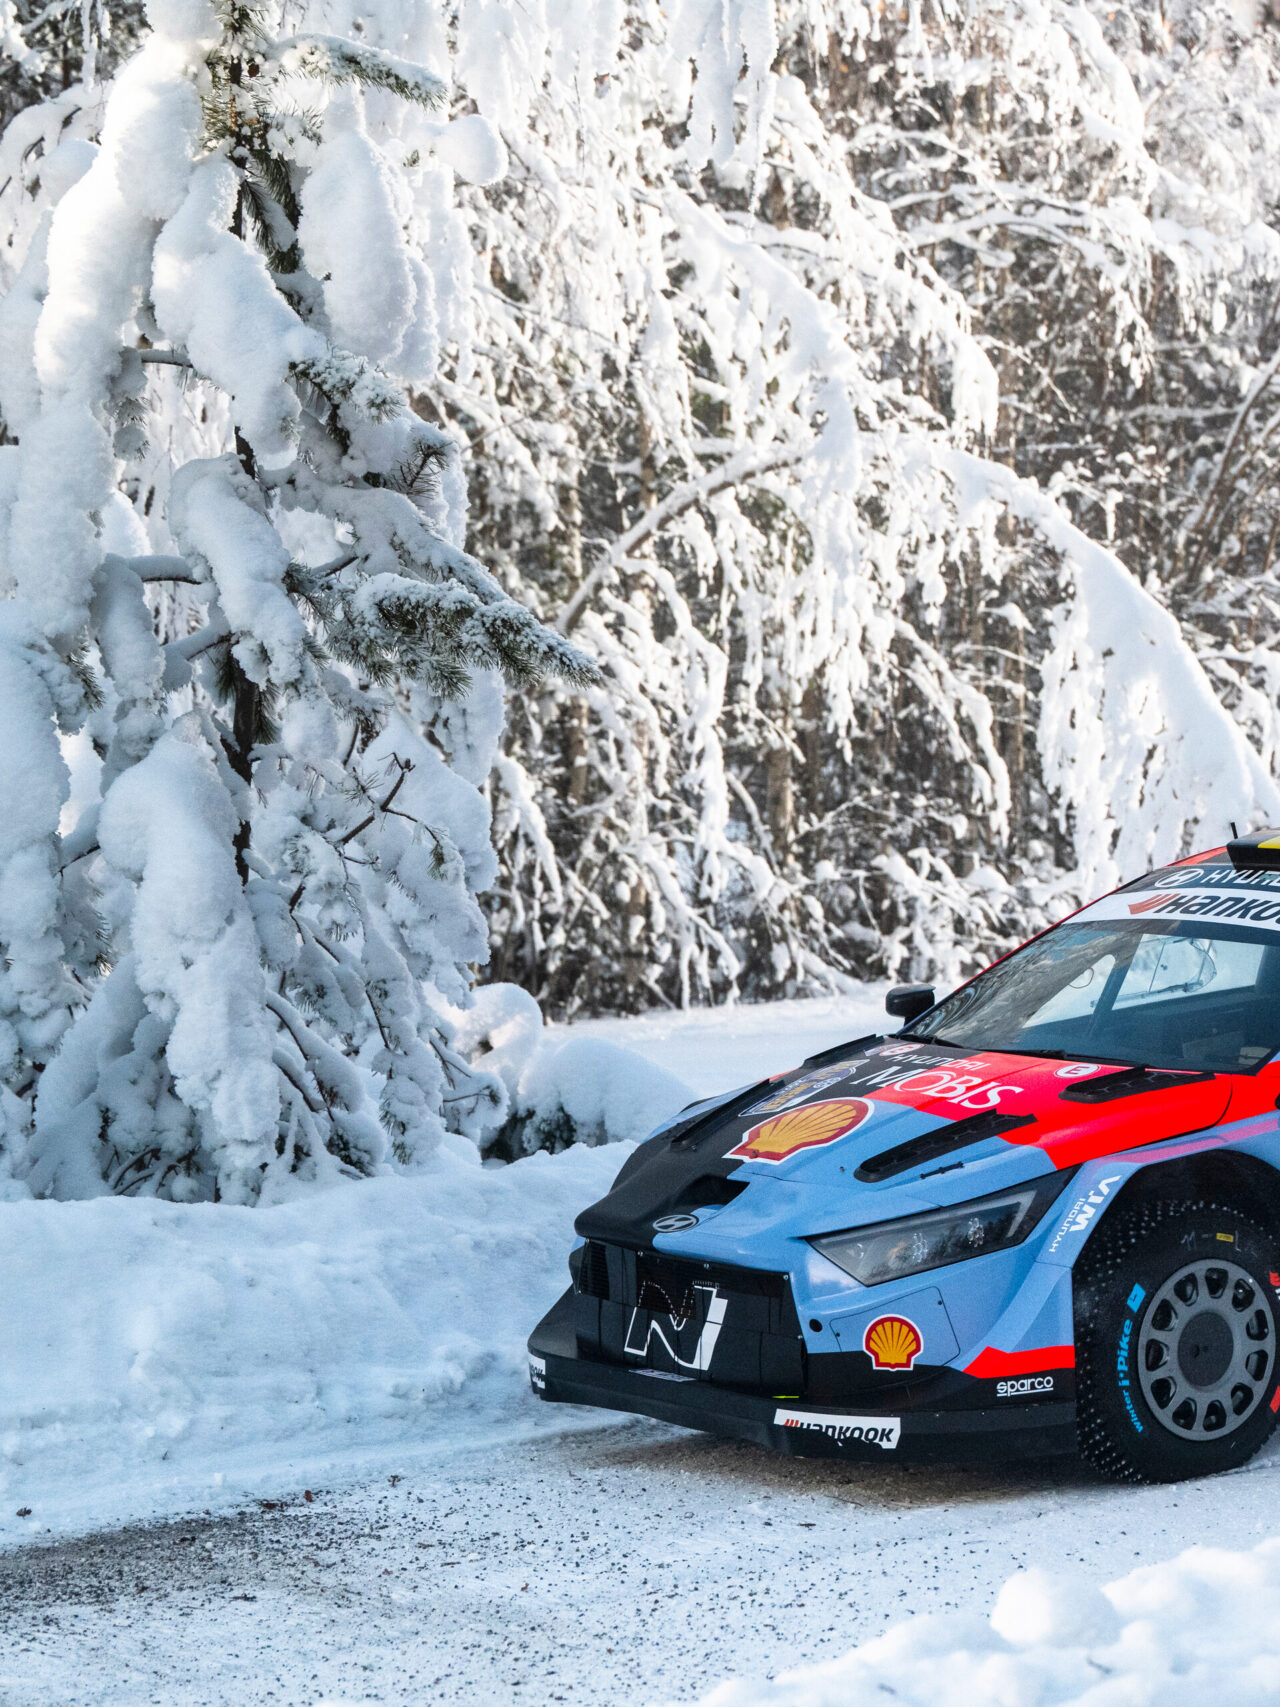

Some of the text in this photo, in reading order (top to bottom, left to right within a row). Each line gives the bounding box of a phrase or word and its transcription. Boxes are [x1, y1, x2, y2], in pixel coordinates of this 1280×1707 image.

[886, 1052, 992, 1071] HYUNDAI
[849, 1066, 1025, 1109] MOBIS
[1048, 1198, 1087, 1252] HYUNDAI
[997, 1376, 1054, 1397] sparco
